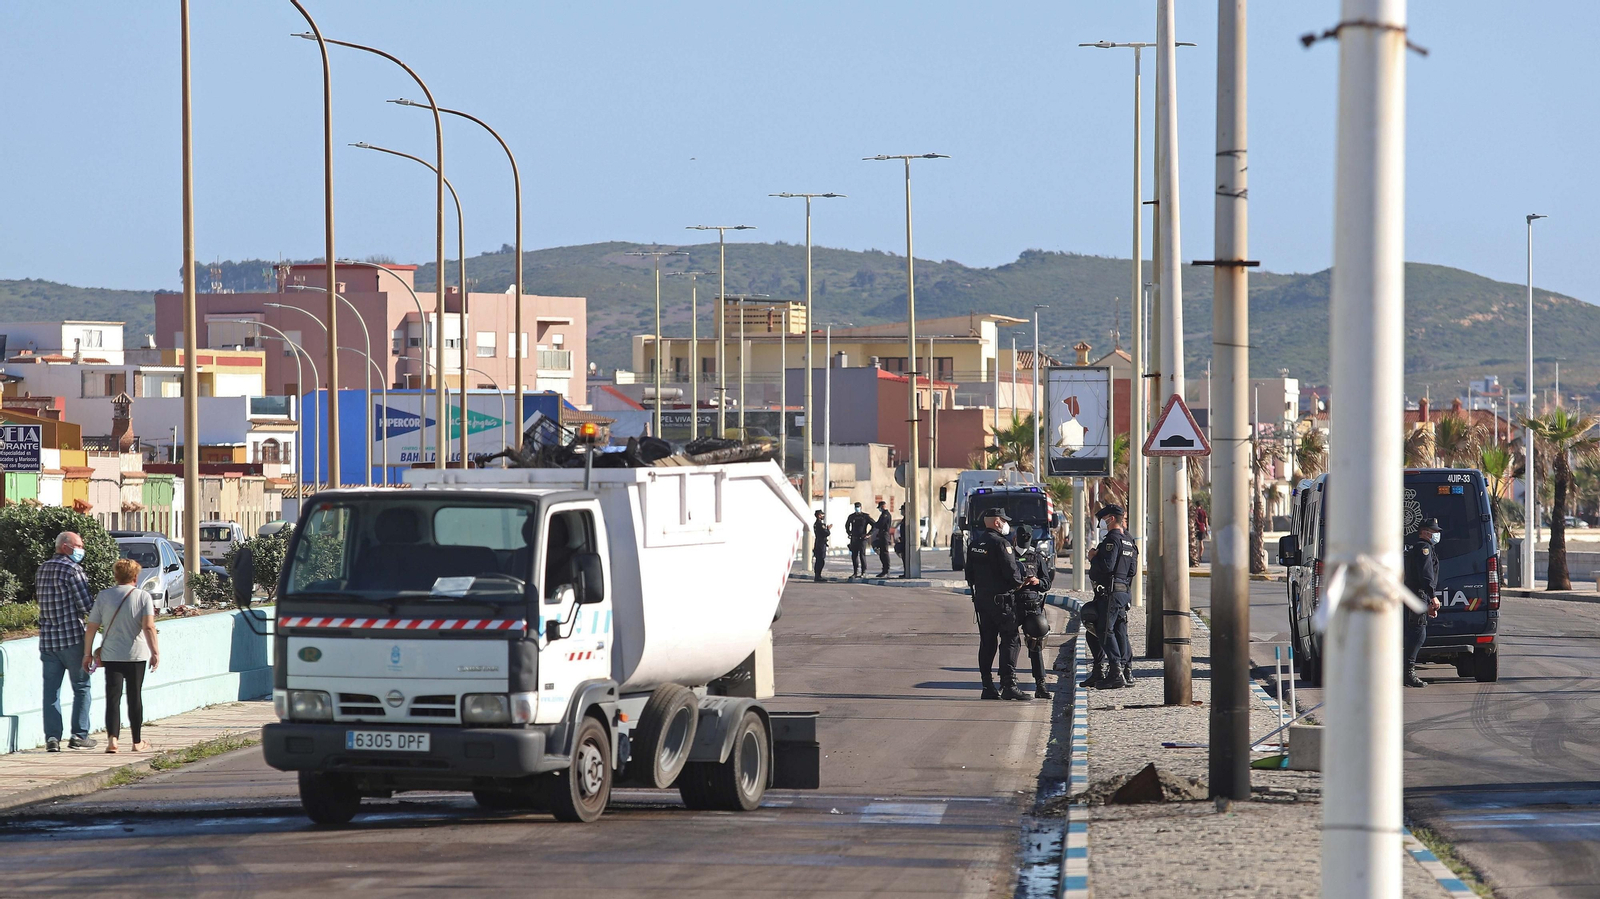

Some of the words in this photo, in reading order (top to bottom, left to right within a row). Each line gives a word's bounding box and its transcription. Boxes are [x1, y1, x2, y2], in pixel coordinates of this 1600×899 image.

[378, 418, 421, 428] HPERCOR
[1447, 474, 1471, 482] 4UIP-33
[355, 733, 393, 748] 6305
[397, 734, 425, 749] DPF
